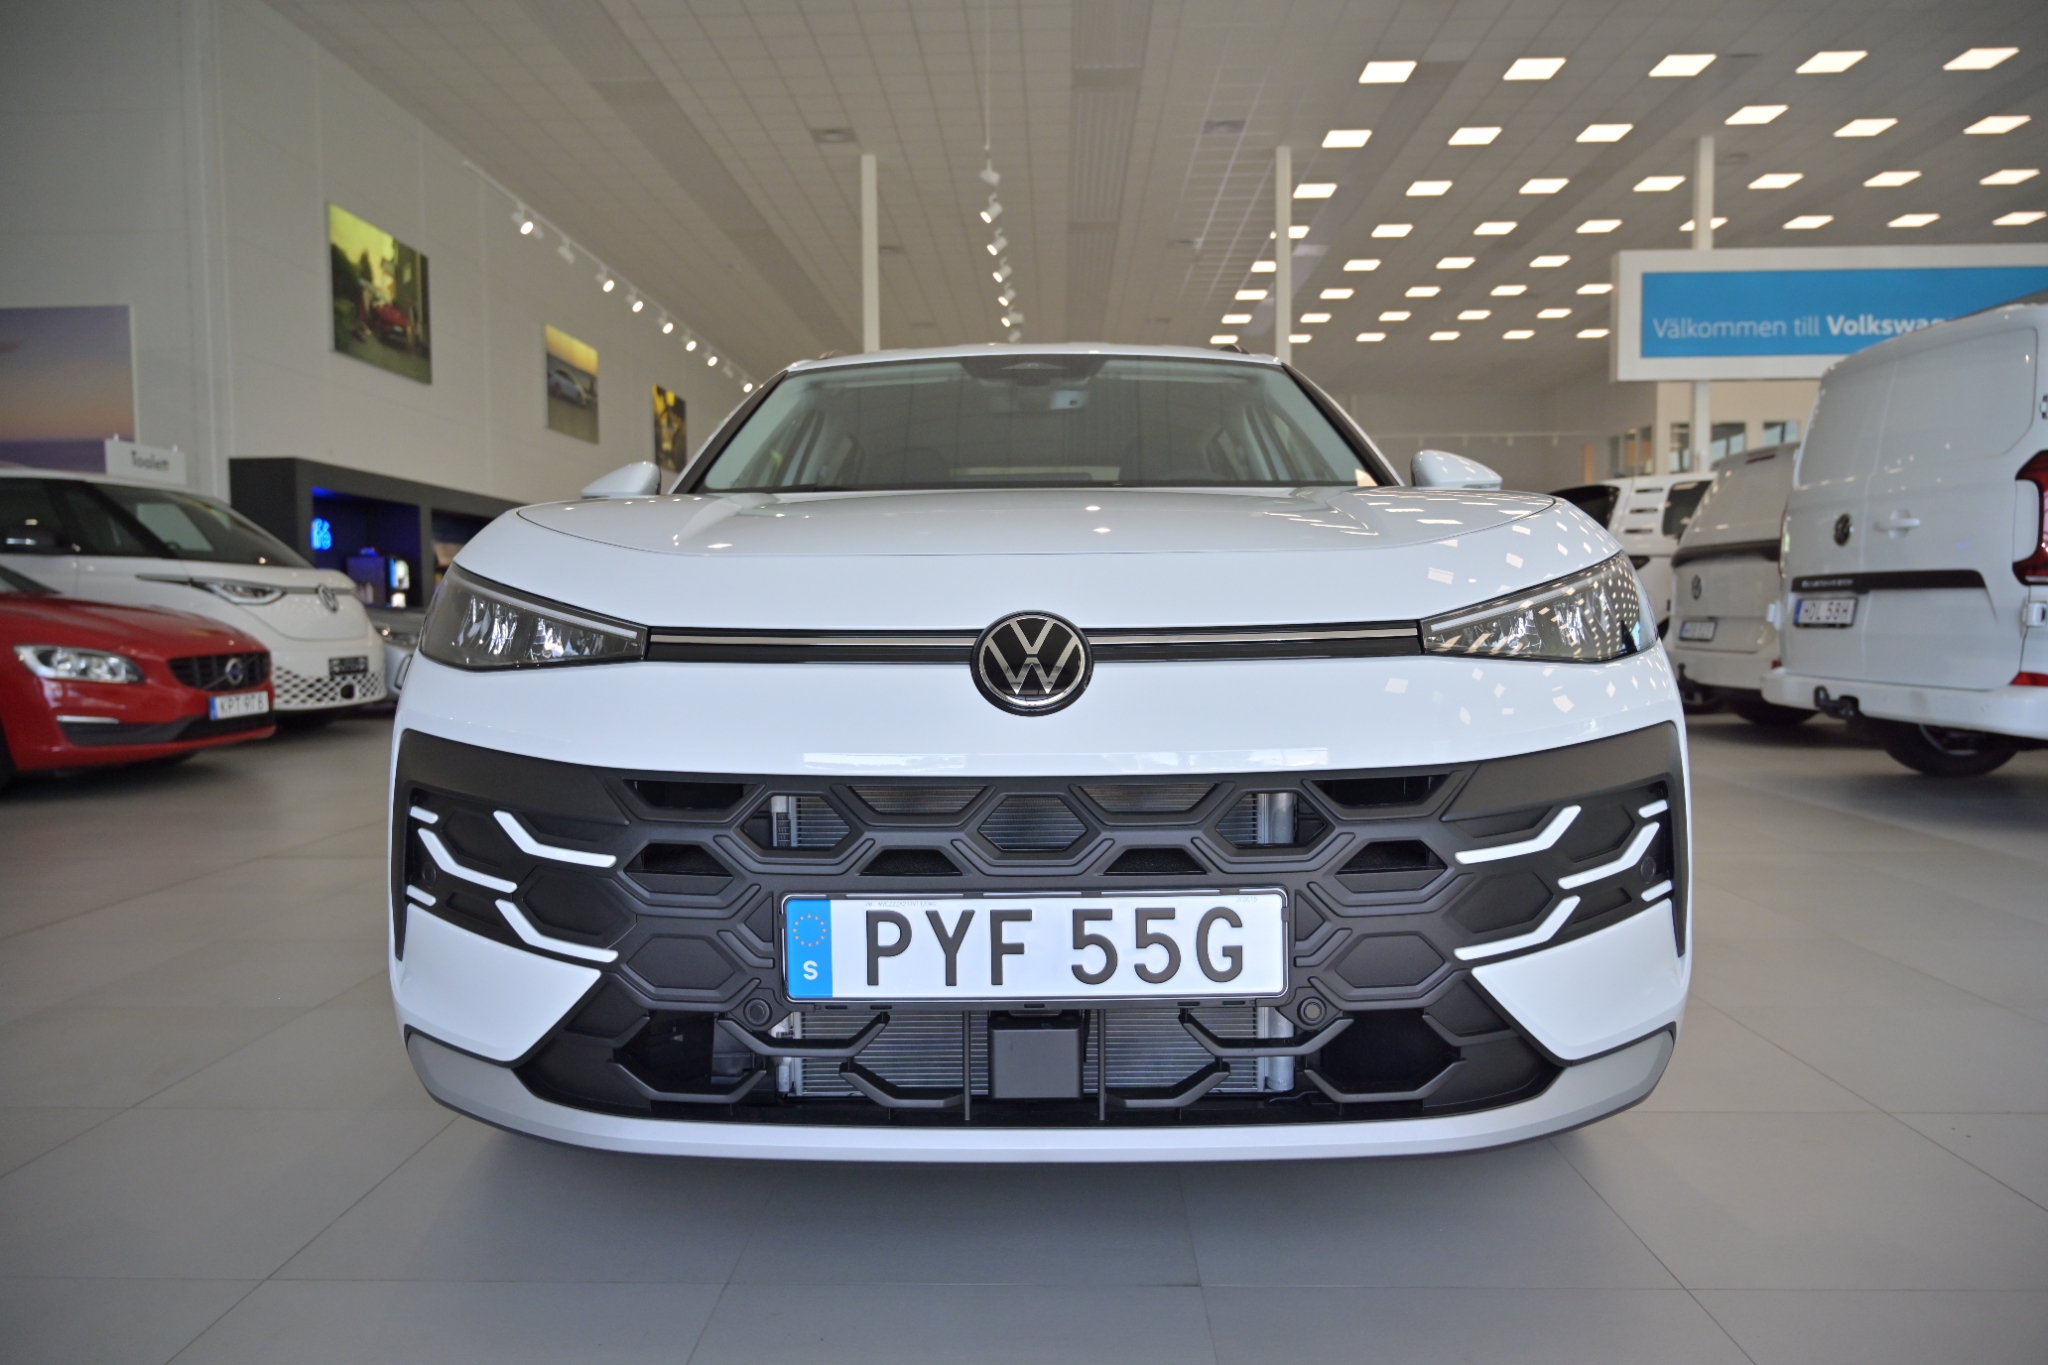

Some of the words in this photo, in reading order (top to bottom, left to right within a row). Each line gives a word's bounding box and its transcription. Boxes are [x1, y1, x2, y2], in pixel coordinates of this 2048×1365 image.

[1652, 317, 1787, 339] Välkommen
[1794, 315, 1820, 337] till
[865, 908, 1033, 987] PYF
[1070, 906, 1245, 986] 55G
[803, 960, 819, 980] S
